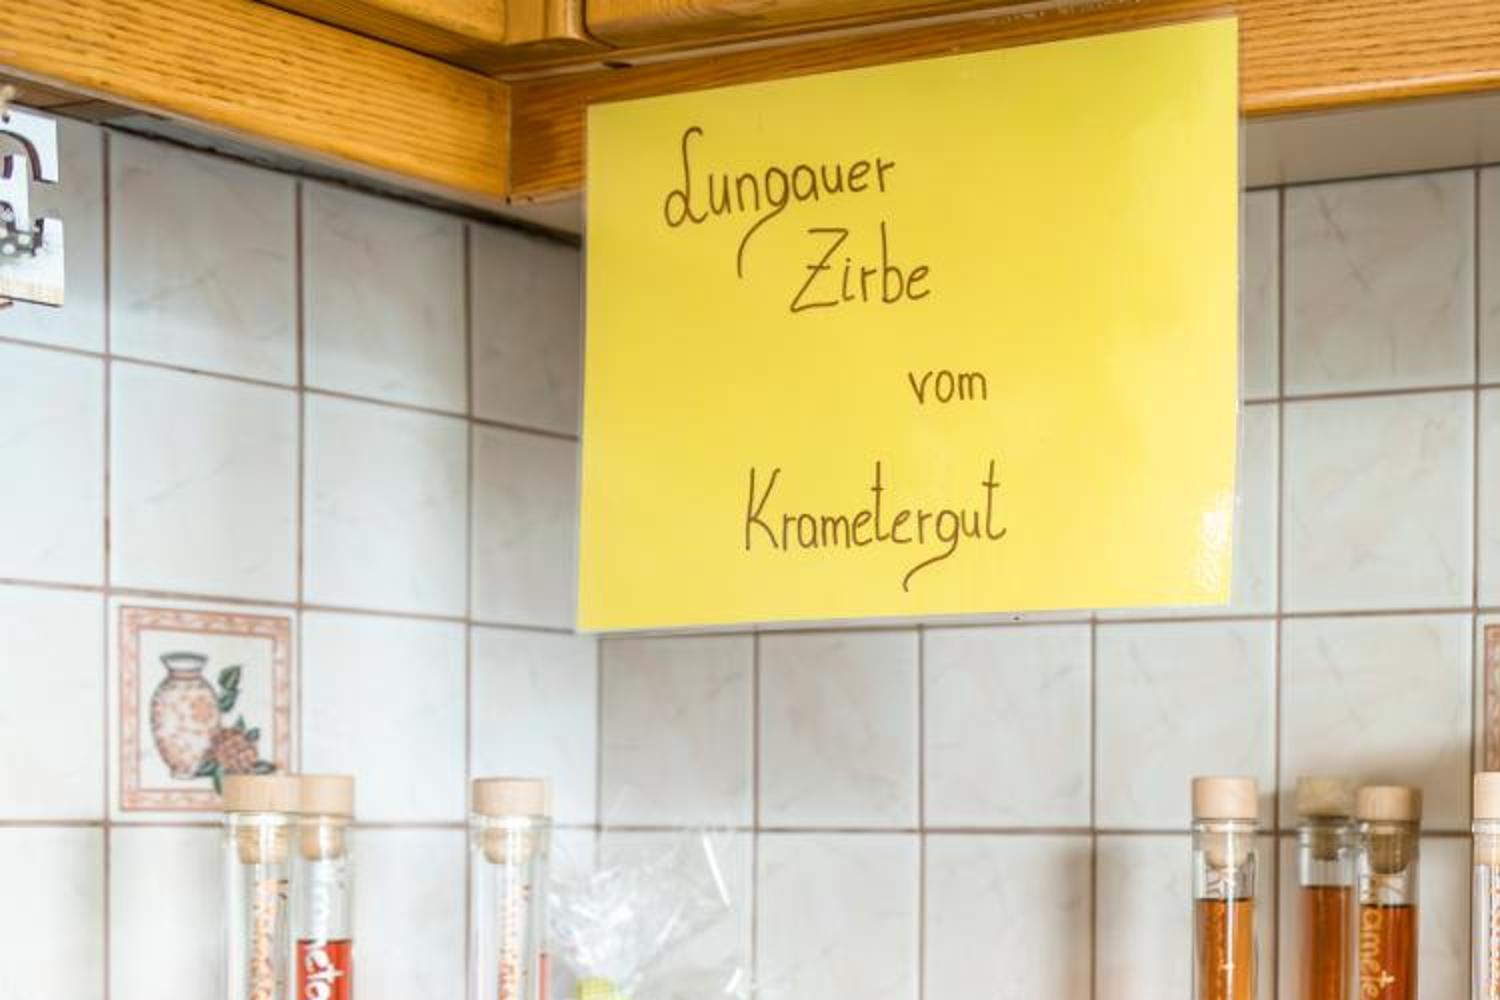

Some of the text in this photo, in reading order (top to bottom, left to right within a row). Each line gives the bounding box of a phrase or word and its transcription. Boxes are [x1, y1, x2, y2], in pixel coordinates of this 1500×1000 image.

[663, 126, 896, 279] Lungauer
[791, 221, 931, 313] Zirbe
[907, 368, 988, 405] vom
[745, 459, 1007, 592] Krametergut
